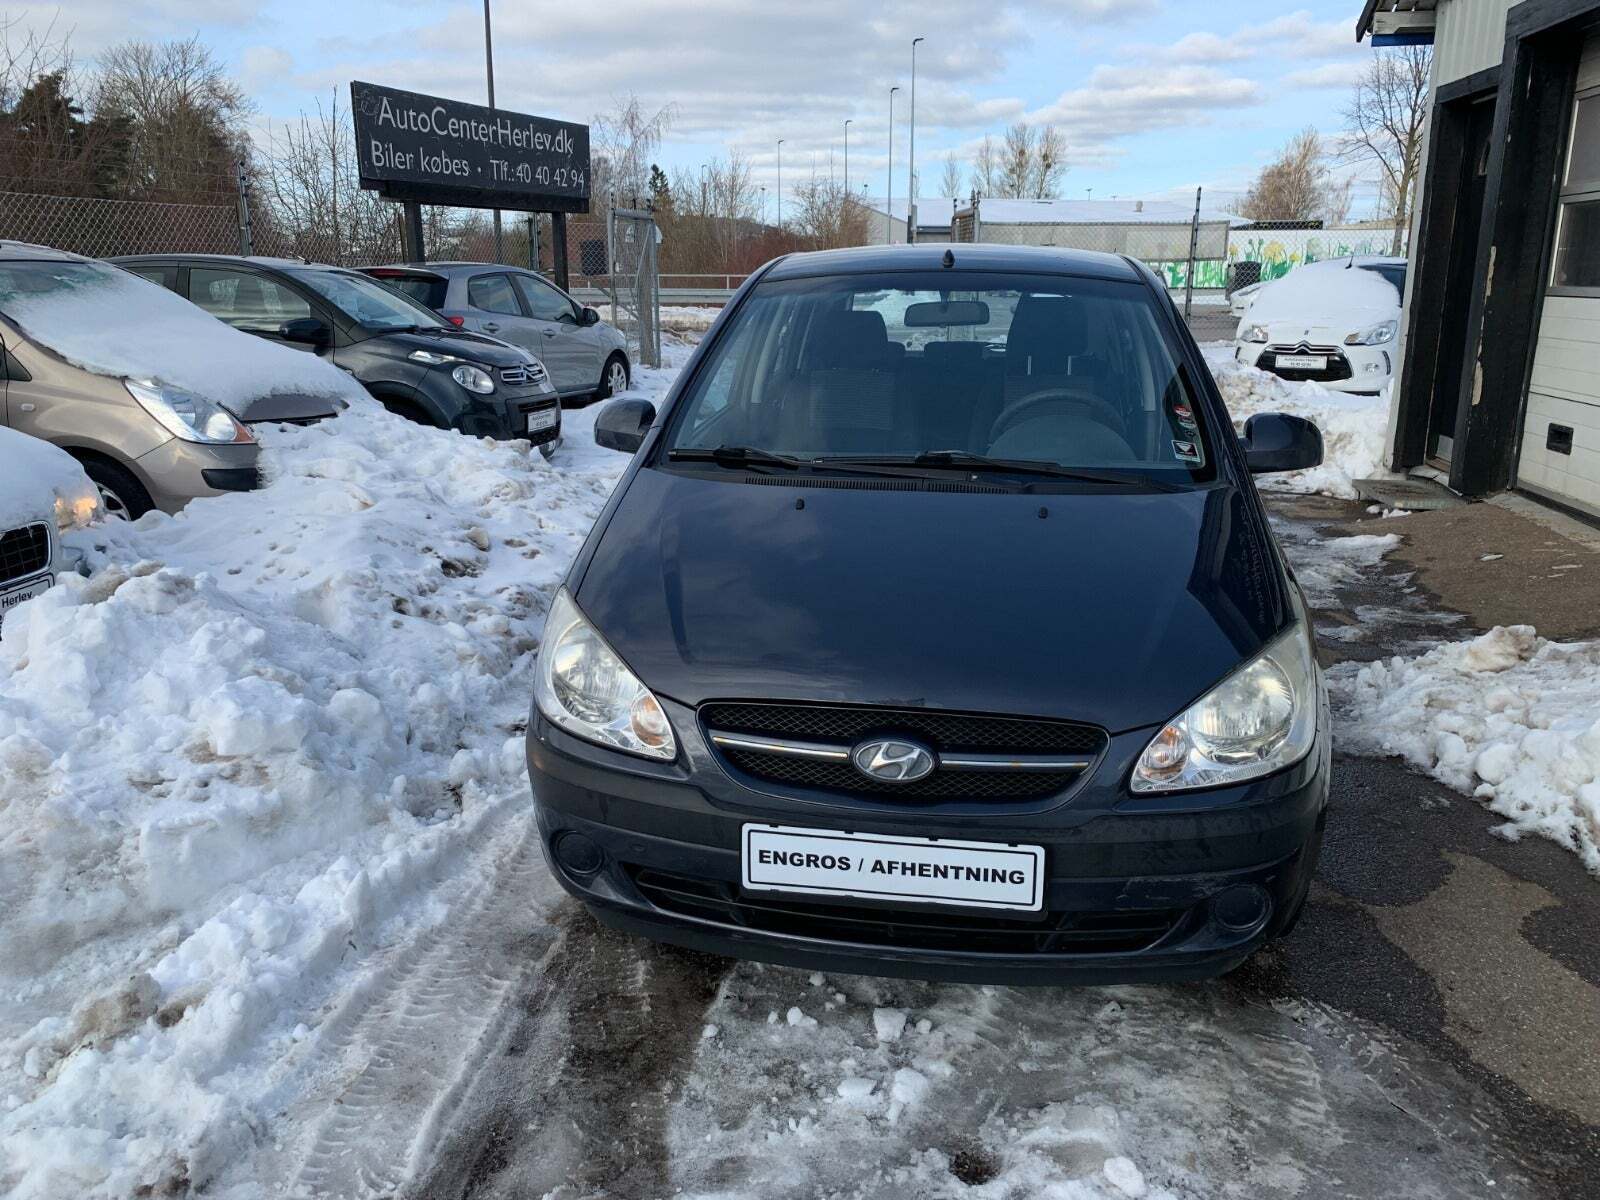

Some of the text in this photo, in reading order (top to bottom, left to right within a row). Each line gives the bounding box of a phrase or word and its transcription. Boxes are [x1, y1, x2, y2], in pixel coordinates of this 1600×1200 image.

[377, 96, 575, 155] AutoCenterHerlev.dk
[371, 139, 414, 170] Biler
[420, 146, 470, 177] købes
[535, 166, 550, 185] 40
[553, 168, 568, 187] 42
[571, 169, 585, 190] 94
[1, 591, 33, 608] Herlev
[758, 849, 1026, 885] ENGROS / AFHENTNING
